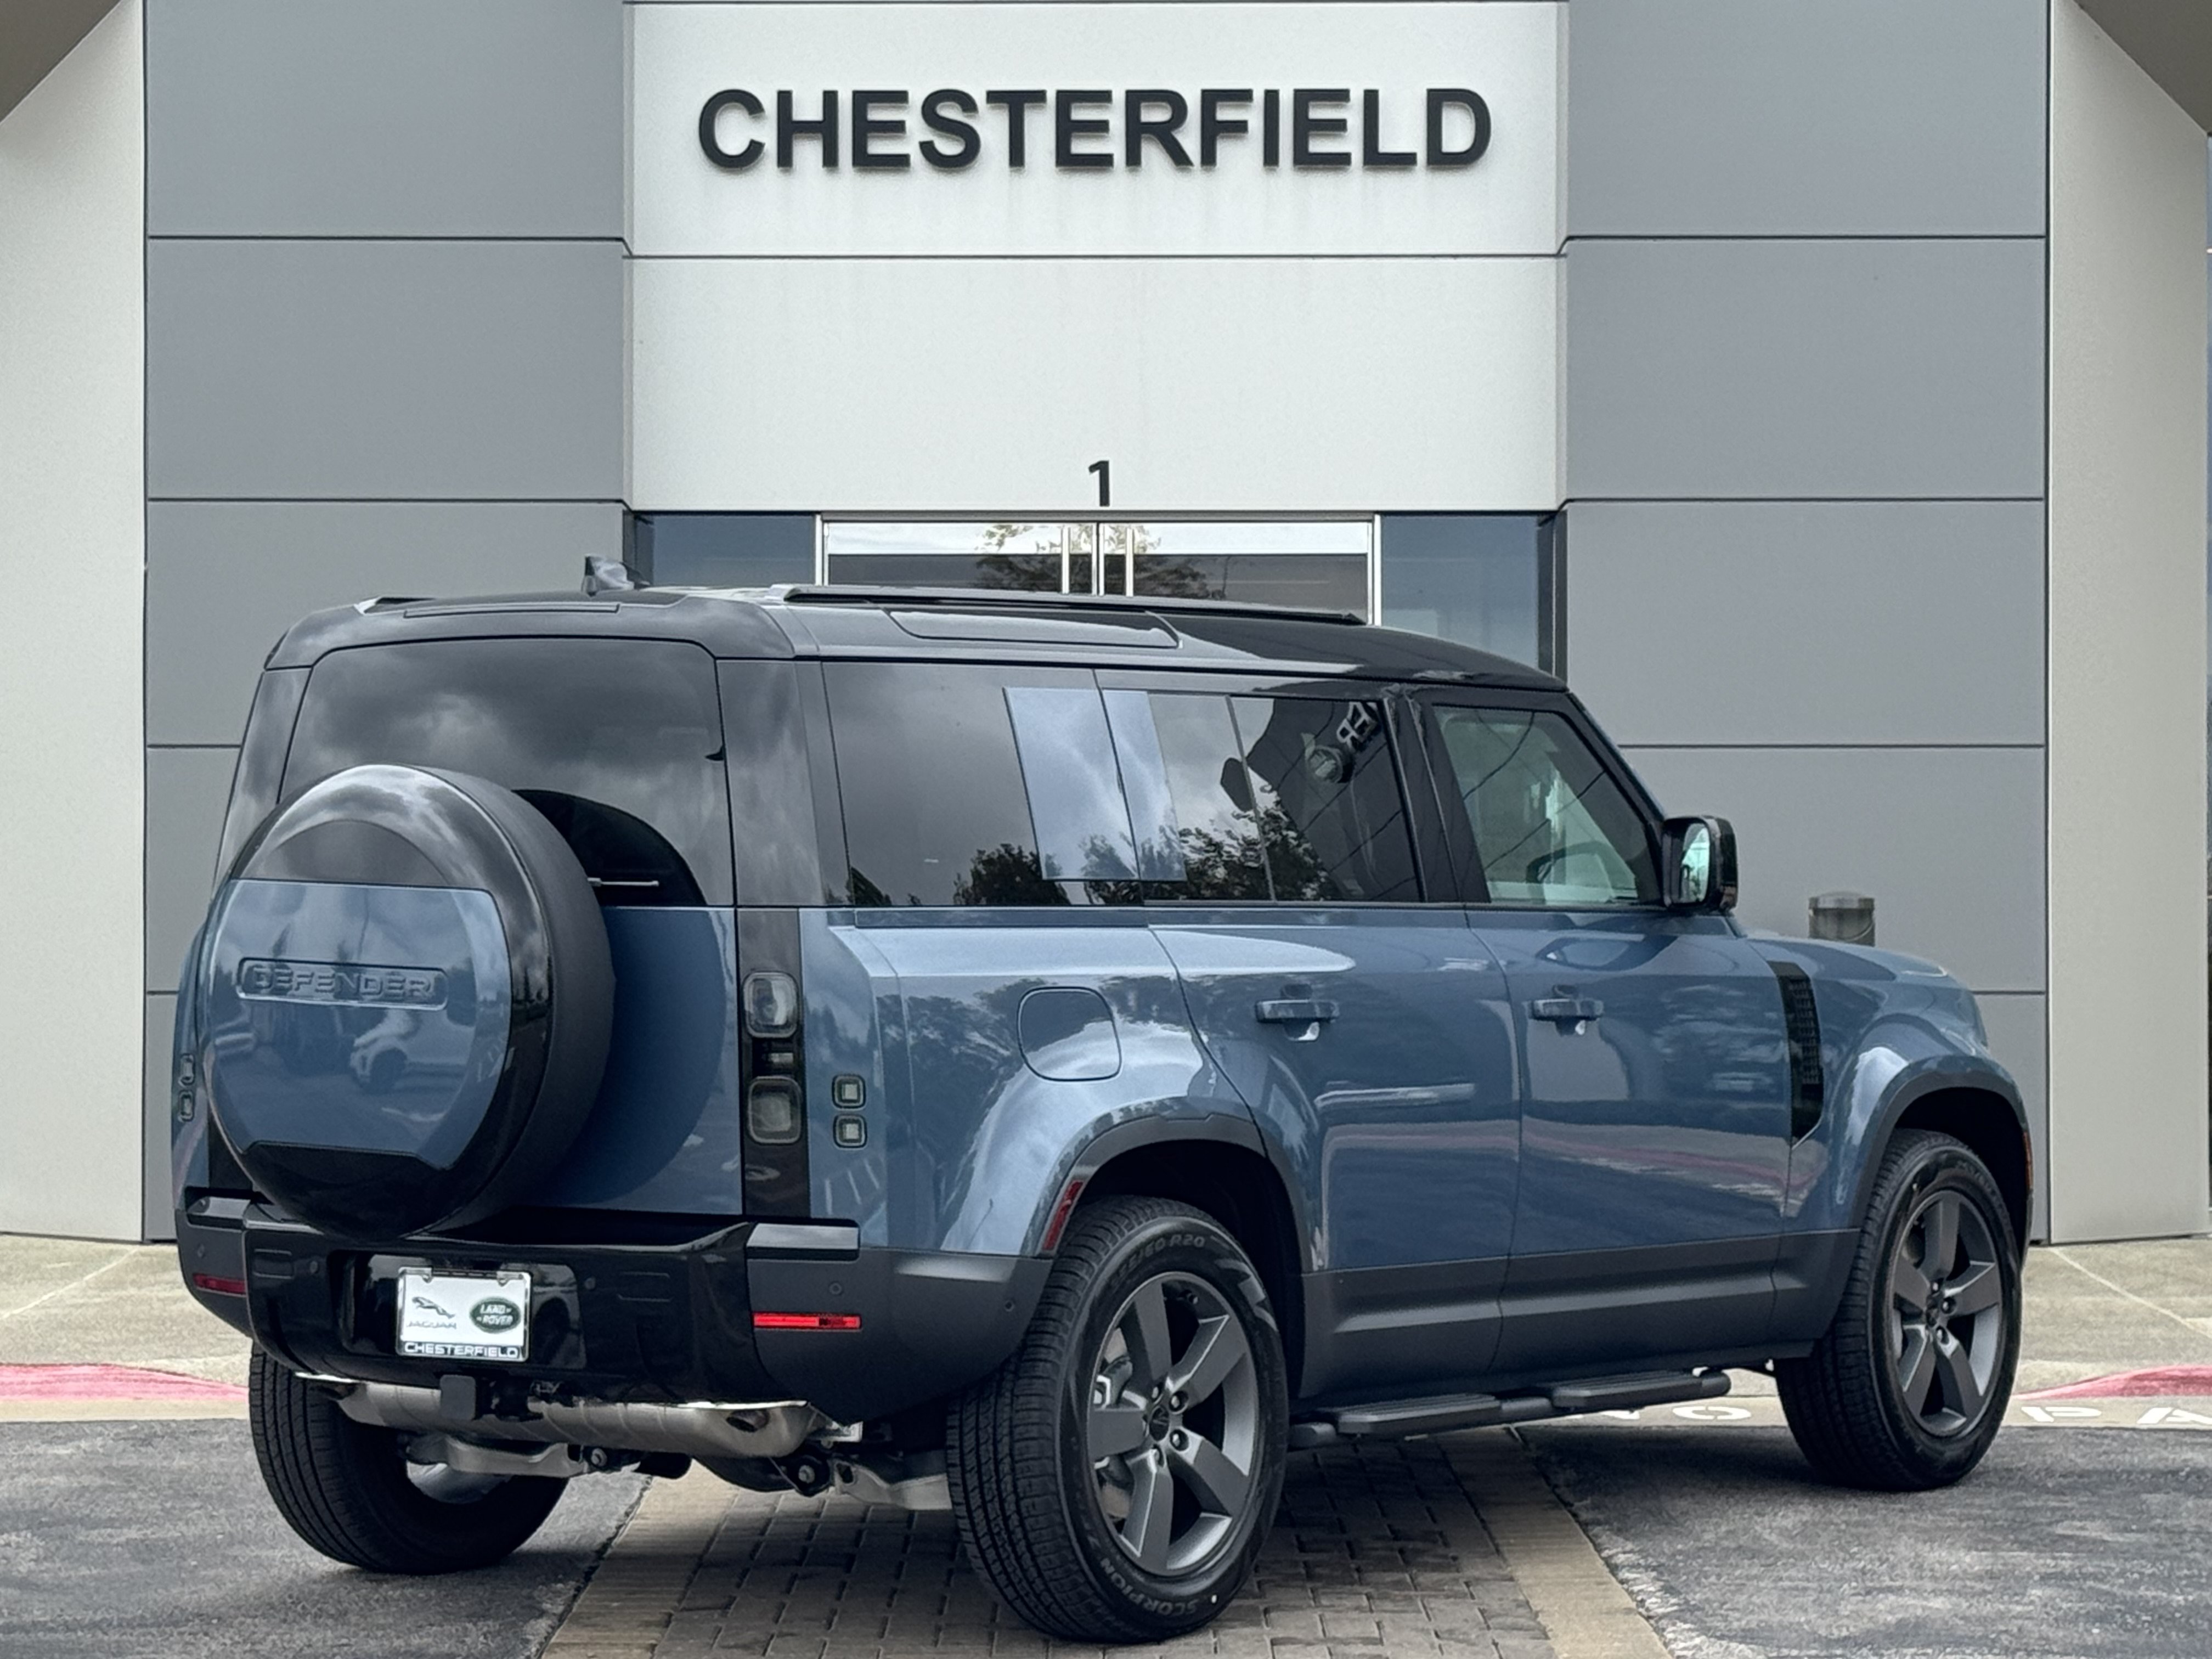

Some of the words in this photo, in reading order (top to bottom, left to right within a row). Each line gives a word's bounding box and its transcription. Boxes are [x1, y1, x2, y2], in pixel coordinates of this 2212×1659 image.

[699, 89, 1491, 172] CHESTERFIELD
[1089, 461, 1109, 506] 1
[251, 964, 435, 999] DEFENDER
[480, 1304, 506, 1314] LAND
[483, 1314, 513, 1326] ROVER
[404, 1342, 518, 1358] CHESTERFIELD
[1099, 1558, 1200, 1617] SCORPION
